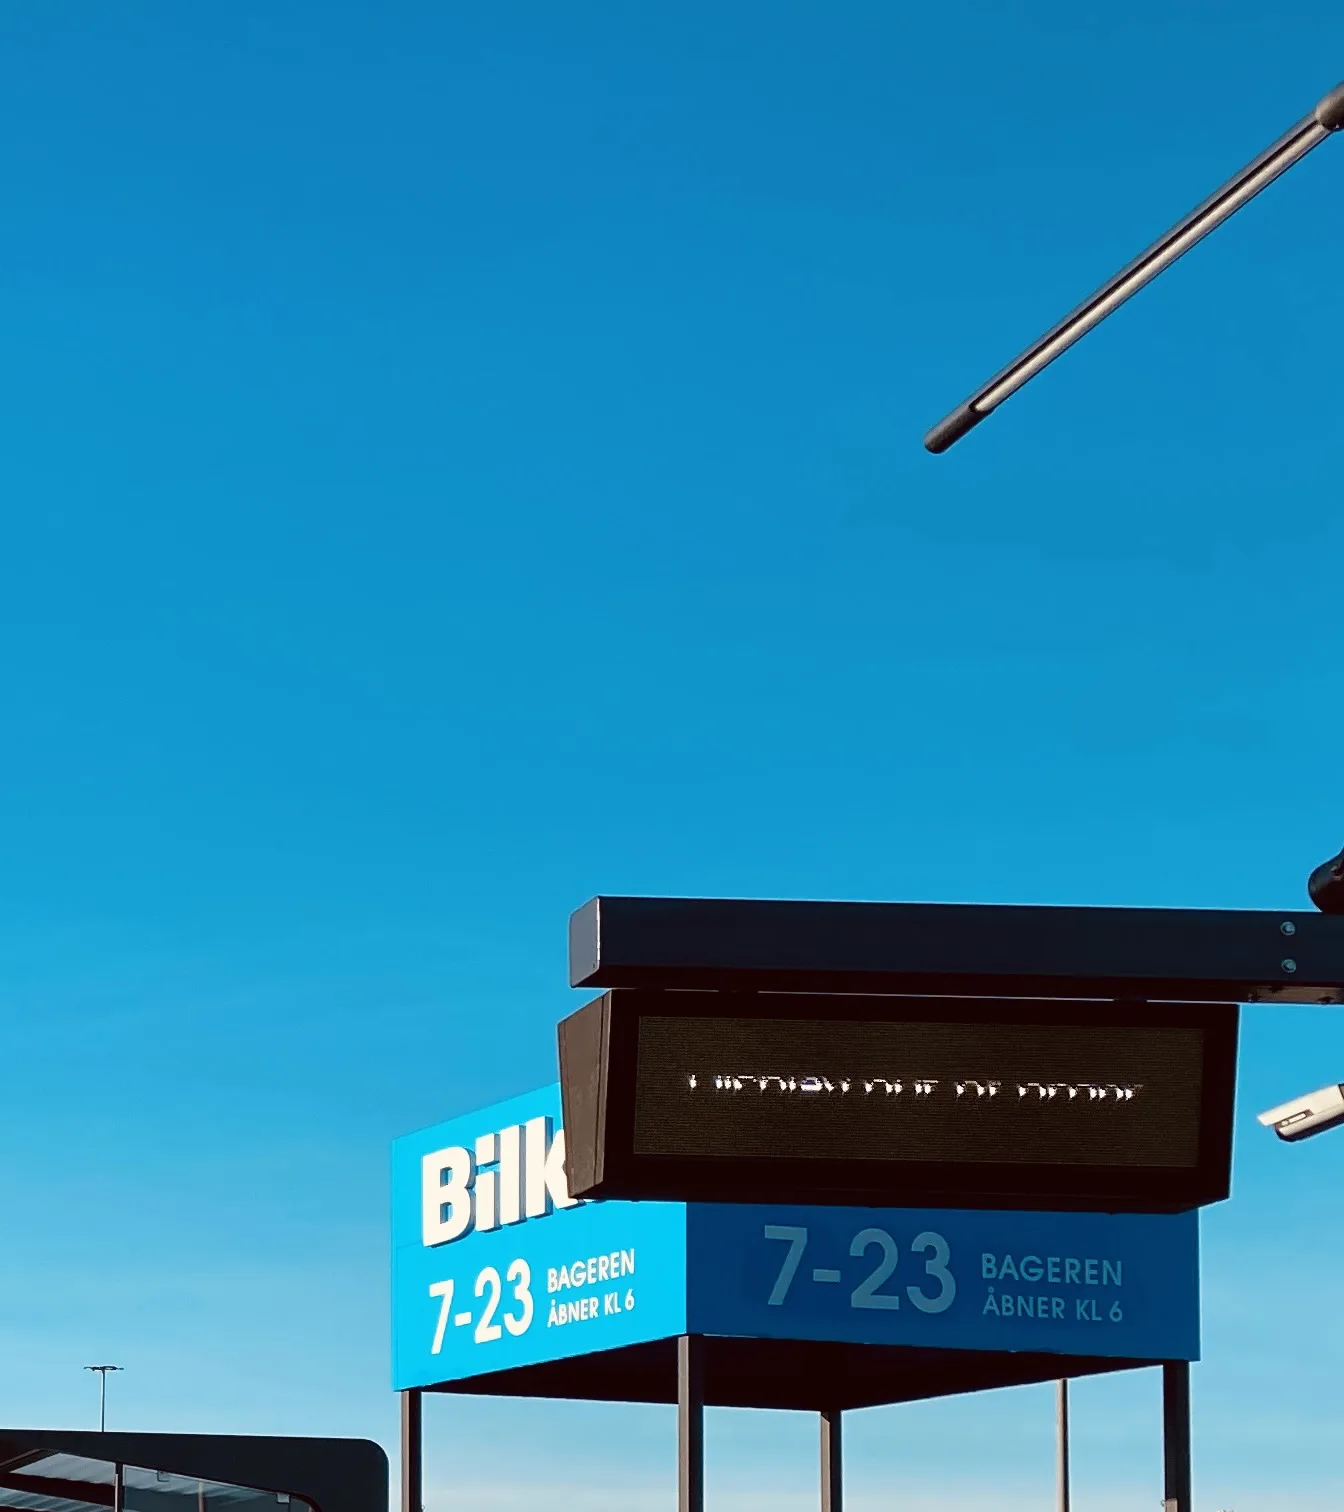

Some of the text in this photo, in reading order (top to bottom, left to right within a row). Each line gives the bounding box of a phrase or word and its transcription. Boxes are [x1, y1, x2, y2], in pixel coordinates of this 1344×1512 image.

[422, 1115, 596, 1248] Bilk
[547, 1248, 636, 1294] BAGEREN
[765, 1225, 957, 1314] 7-23
[981, 1253, 1123, 1287] BAGEREN
[429, 1258, 534, 1355] 7-23
[547, 1289, 636, 1328] ÅBNER KL 6
[982, 1286, 1123, 1323] ÅBNER KL 6
